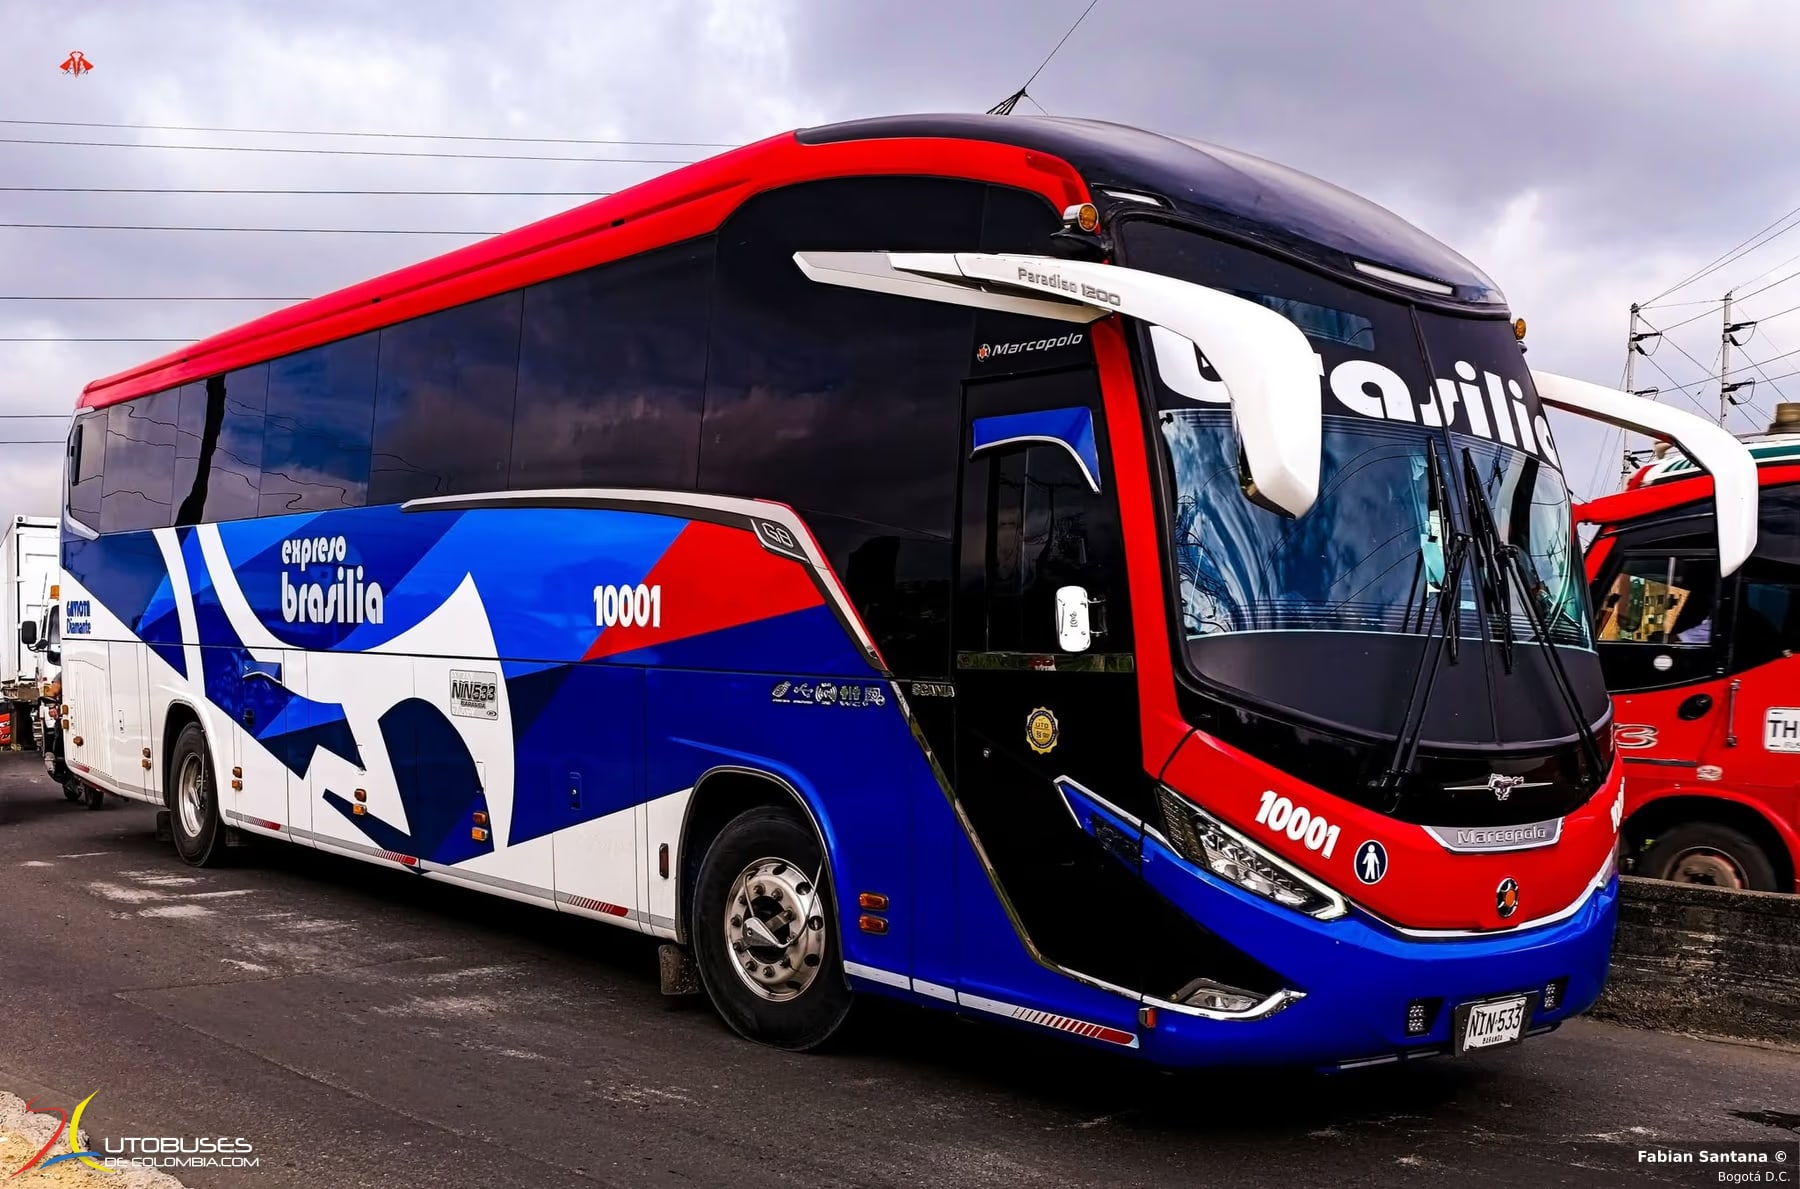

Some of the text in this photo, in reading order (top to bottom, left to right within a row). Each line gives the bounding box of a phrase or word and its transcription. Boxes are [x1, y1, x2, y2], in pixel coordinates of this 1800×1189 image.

[1018, 267, 1121, 306] Paradiso 1200
[992, 333, 1083, 356] Marcopolo
[762, 522, 794, 548] G8
[282, 536, 347, 572] expreso
[282, 565, 384, 624] brasilia
[593, 583, 661, 628] 10001
[911, 683, 956, 698] SCANIA
[1255, 790, 1341, 860] 10001
[1456, 824, 1546, 845] Marcopolo
